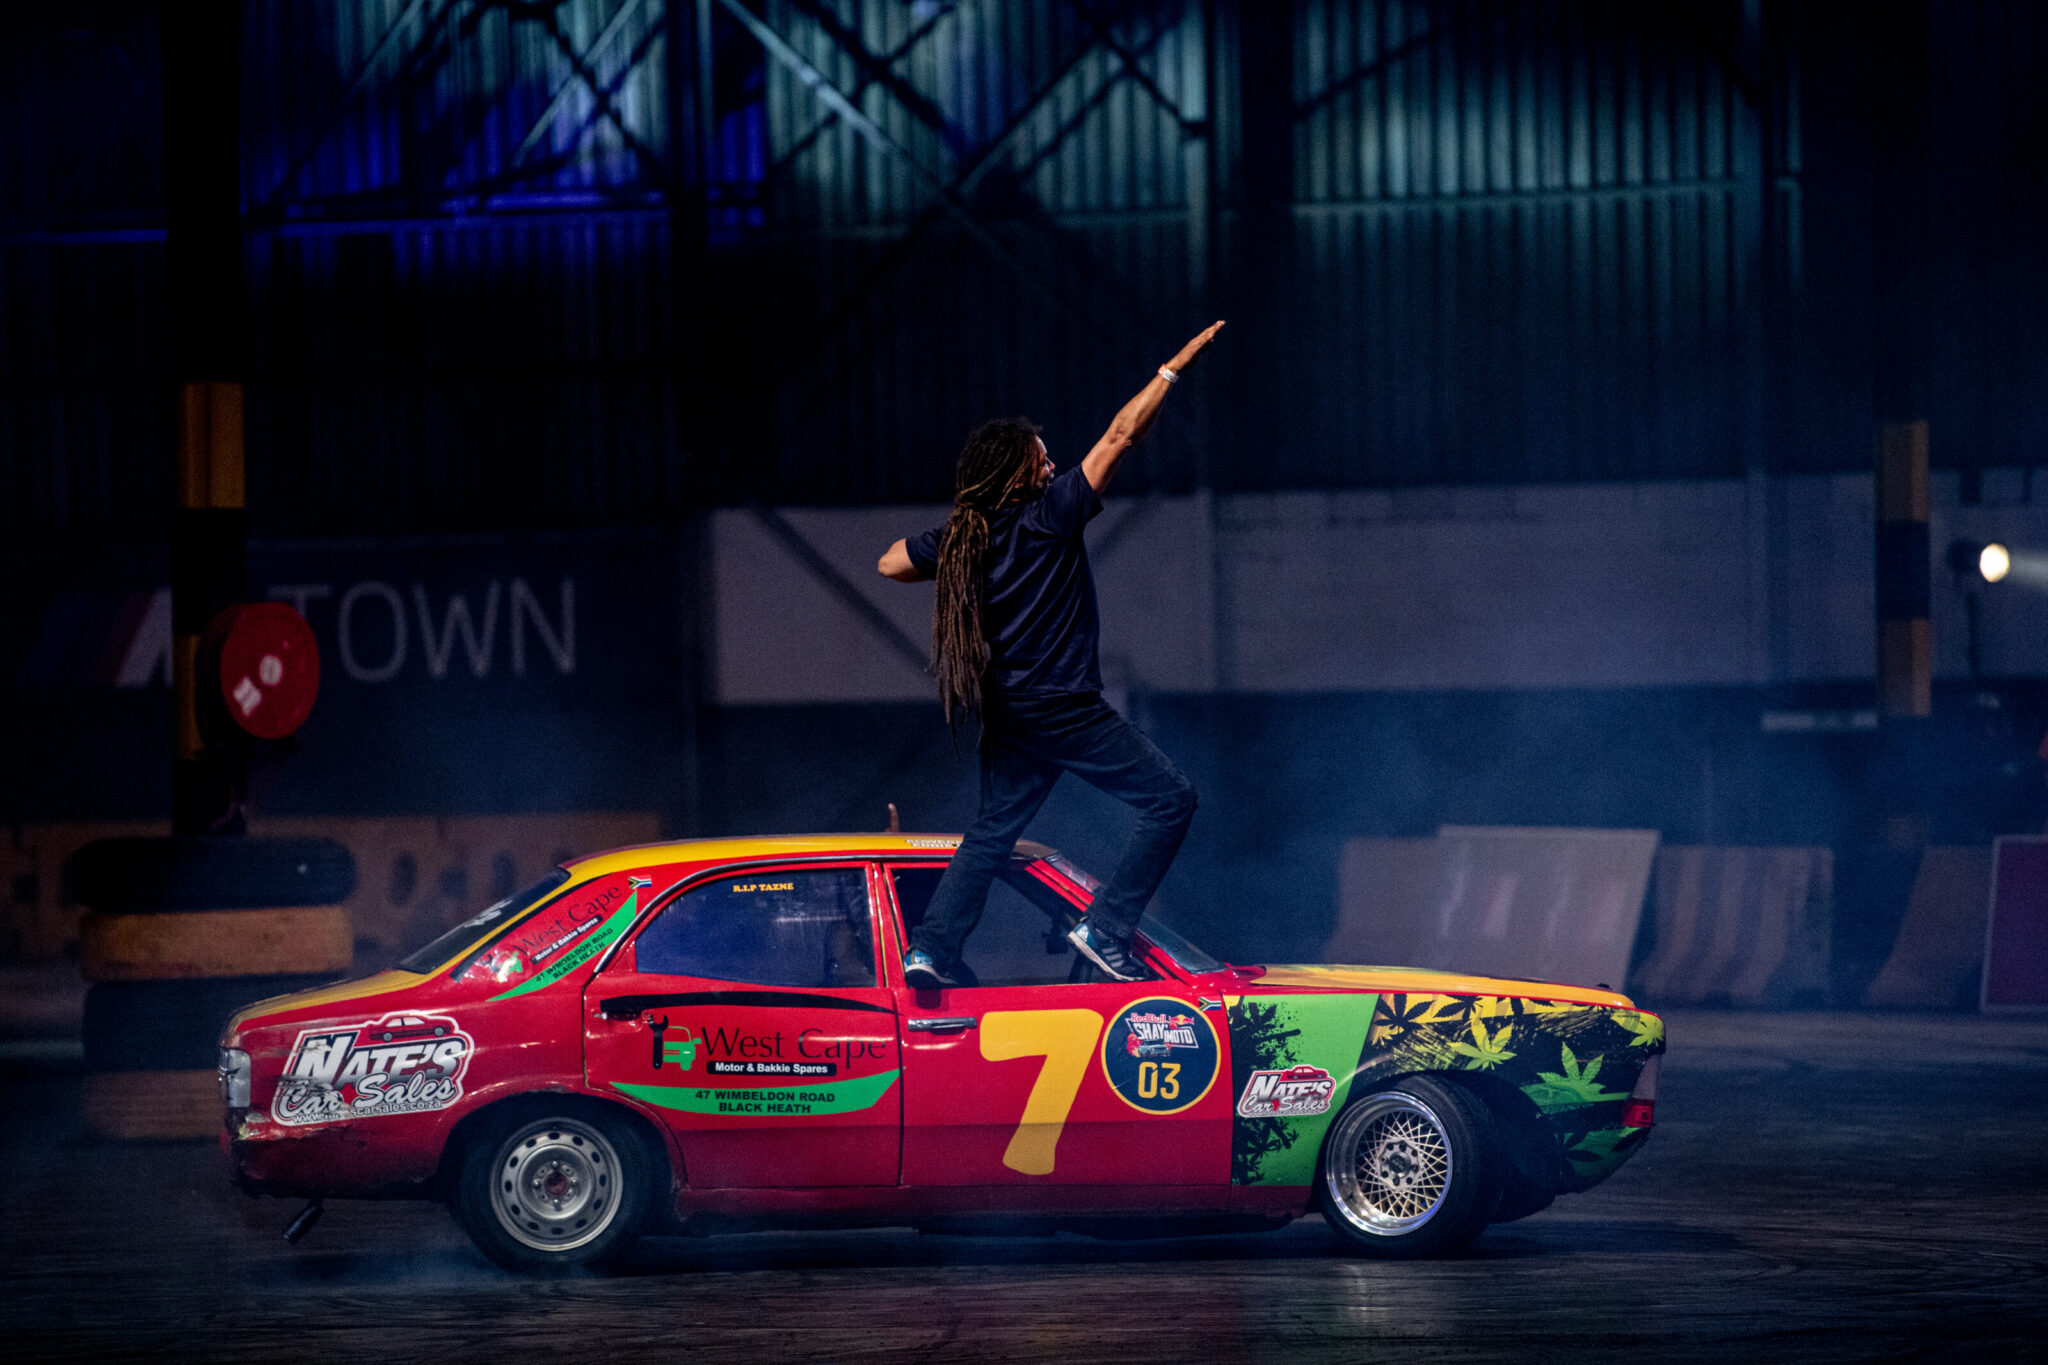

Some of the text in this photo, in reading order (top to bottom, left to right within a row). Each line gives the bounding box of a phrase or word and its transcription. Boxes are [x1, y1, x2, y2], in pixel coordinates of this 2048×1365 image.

[758, 882, 795, 892] TAZNE
[512, 885, 621, 956] West Cape
[591, 928, 613, 943] ROAD
[553, 959, 579, 978] BLACK
[291, 1031, 467, 1086] NATE'S
[701, 1027, 886, 1069] West Cape
[715, 1062, 828, 1076] Motor & Bakkie Spares
[1137, 1061, 1182, 1100] 03
[277, 1071, 456, 1118] Car Sales
[695, 1090, 836, 1103] 47 WIMBELDON ROAD
[979, 1008, 1104, 1175] 7
[1249, 1074, 1333, 1101] NATE'S
[718, 1102, 812, 1114] BLACK HEATH
[1242, 1094, 1273, 1113] Car
[1279, 1095, 1326, 1111] Sales
